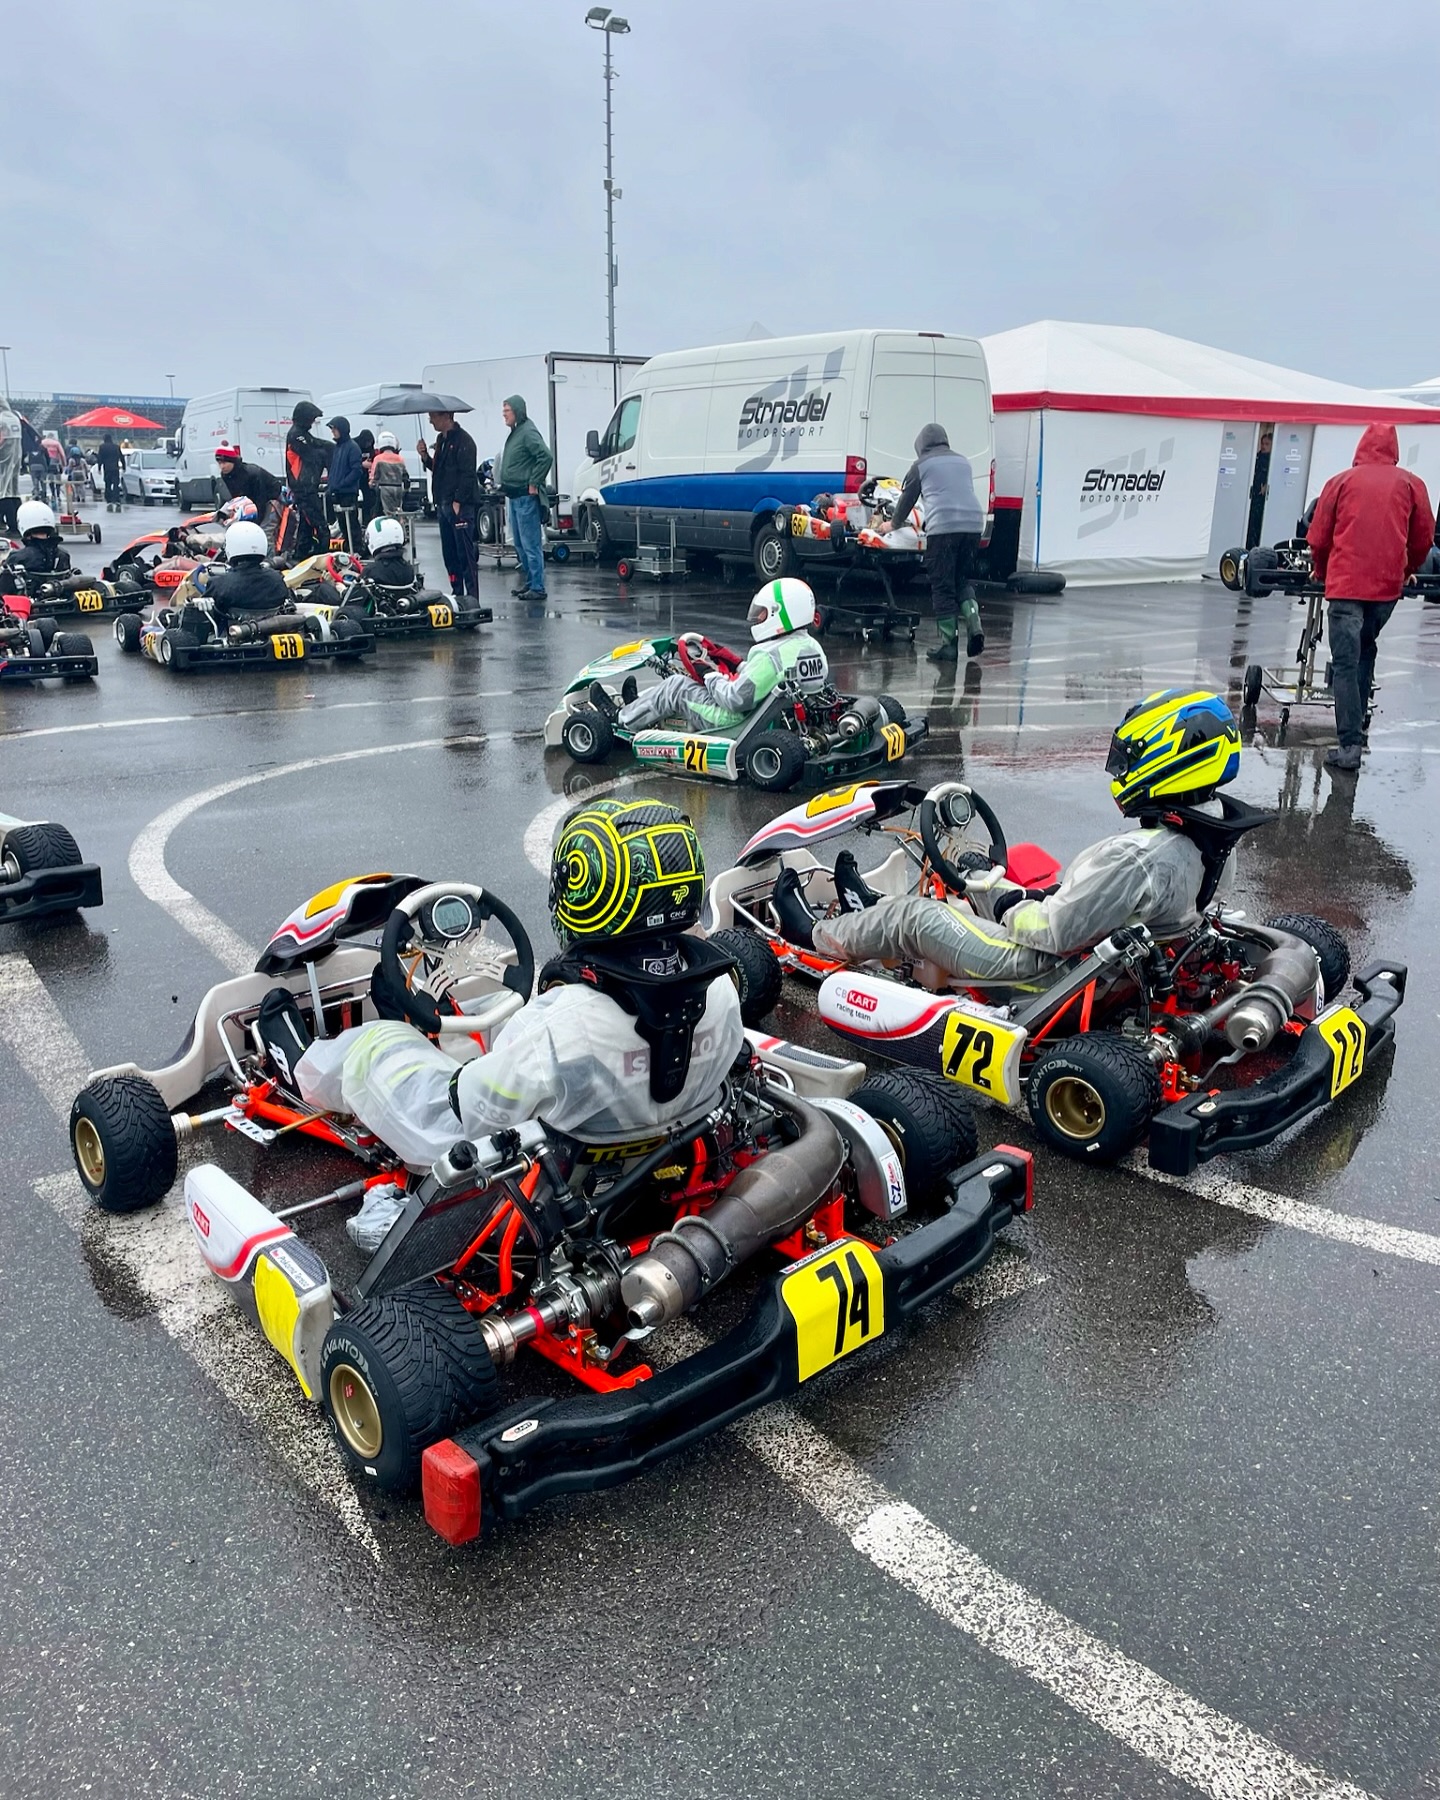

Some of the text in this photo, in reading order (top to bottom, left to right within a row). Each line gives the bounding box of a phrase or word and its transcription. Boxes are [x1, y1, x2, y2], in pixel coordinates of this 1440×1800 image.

[739, 392, 831, 425] Strnadel
[738, 426, 824, 438] MOTORSPORT
[1082, 469, 1166, 491] Strnadel
[1080, 494, 1160, 503] MOTORSPORT
[792, 516, 803, 536] 66
[78, 592, 100, 610] 227
[434, 608, 449, 625] 23
[278, 636, 298, 658] 58
[798, 659, 823, 678] OMP
[886, 724, 901, 758] 27
[685, 740, 708, 772] 27
[836, 1002, 871, 1022] racing team
[946, 1022, 994, 1090] 72
[1332, 1021, 1361, 1093] 72
[814, 1250, 870, 1357] 74
[321, 1337, 359, 1369] LEVANTO
